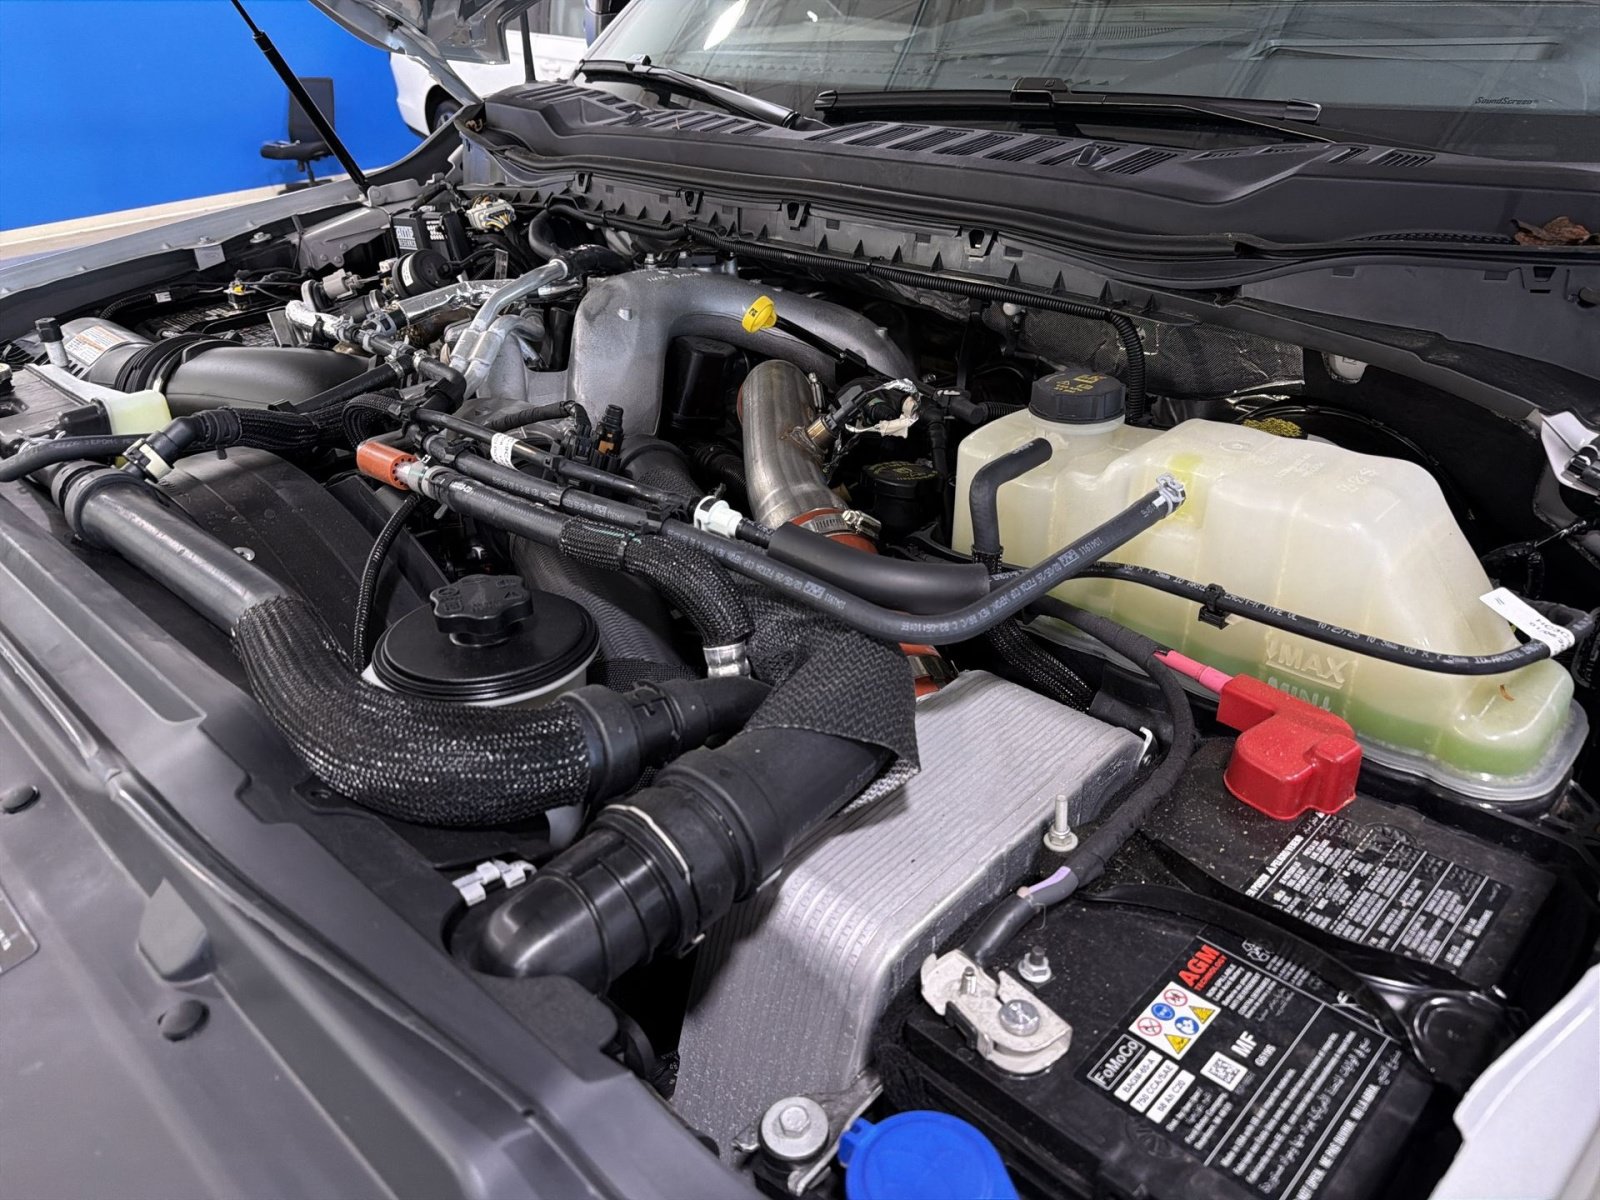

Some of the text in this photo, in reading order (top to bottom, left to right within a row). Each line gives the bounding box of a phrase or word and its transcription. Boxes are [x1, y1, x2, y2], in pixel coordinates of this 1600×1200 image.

[1278, 641, 1346, 684] MAX
[1176, 942, 1221, 986] AGM
[1193, 954, 1228, 992] TECHNOLOGY
[1228, 966, 1245, 982] Battery
[1230, 1030, 1260, 1058] MF
[1094, 1038, 1140, 1084] FoMoCo
[1144, 1062, 1175, 1094] CCA/SAE
[1276, 1066, 1297, 1091] materials.
[1162, 1092, 1176, 1105] Ah
[1170, 1078, 1187, 1094] C20
[1262, 1087, 1282, 1110] imported
[1359, 1081, 1382, 1103] ABRA.
[1255, 1107, 1268, 1119] and
[1347, 1106, 1365, 1121] NO
[1354, 1098, 1371, 1111] LA
[1184, 1128, 1200, 1145] Ford
[1194, 1113, 1211, 1131] Motor
[1205, 1089, 1229, 1117] Company,
[1250, 1115, 1261, 1126] US
[1235, 1134, 1248, 1147] USA
[1242, 1122, 1256, 1137] with
[1331, 1117, 1358, 1146] OUVRIR.
[1220, 1150, 1237, 1168] Made
[1316, 1154, 1335, 1169] NE
[1323, 1141, 1343, 1159] PAS
[1303, 1165, 1327, 1189] OPEN.
